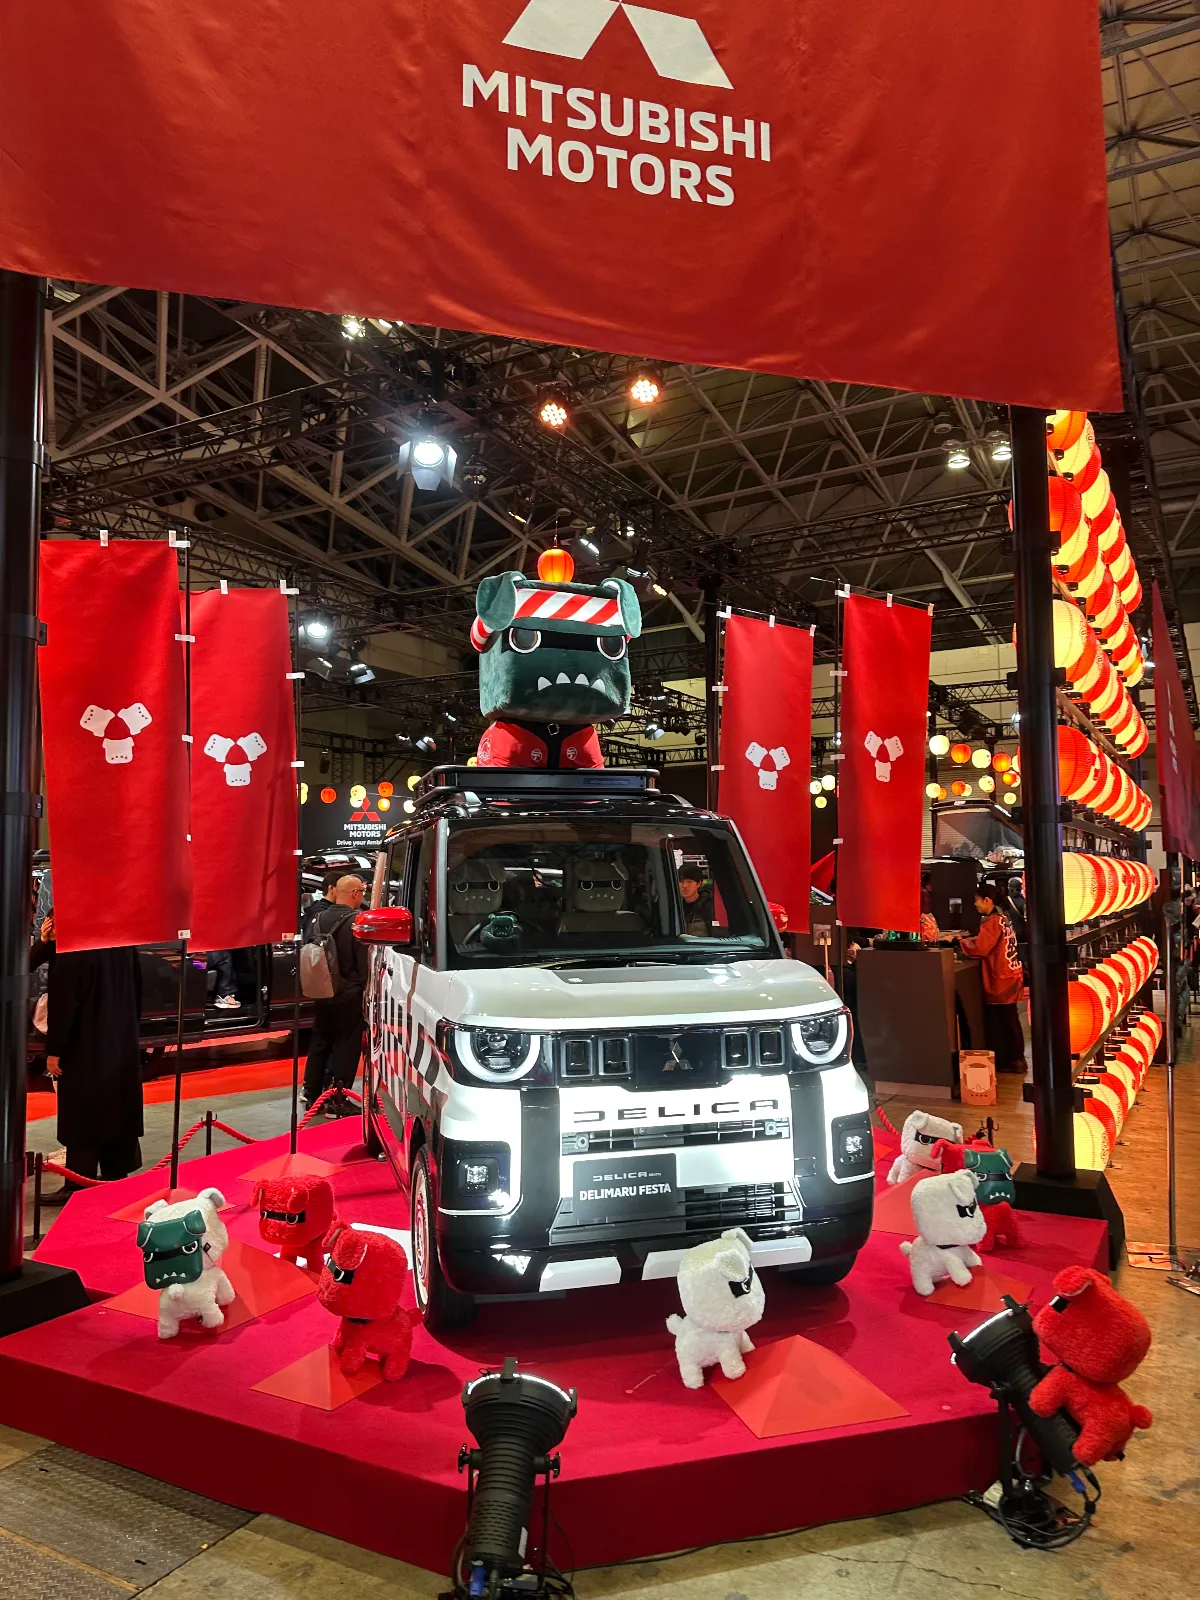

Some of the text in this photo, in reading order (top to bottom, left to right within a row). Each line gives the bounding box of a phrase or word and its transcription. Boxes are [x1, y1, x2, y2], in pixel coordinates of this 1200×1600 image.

[462, 63, 771, 162] MITSUBISHI
[507, 127, 735, 207] MOTORS
[573, 1099, 779, 1124] DELICA
[592, 1171, 648, 1182] DELICA
[579, 1182, 672, 1201] DELIMARU FESTA
